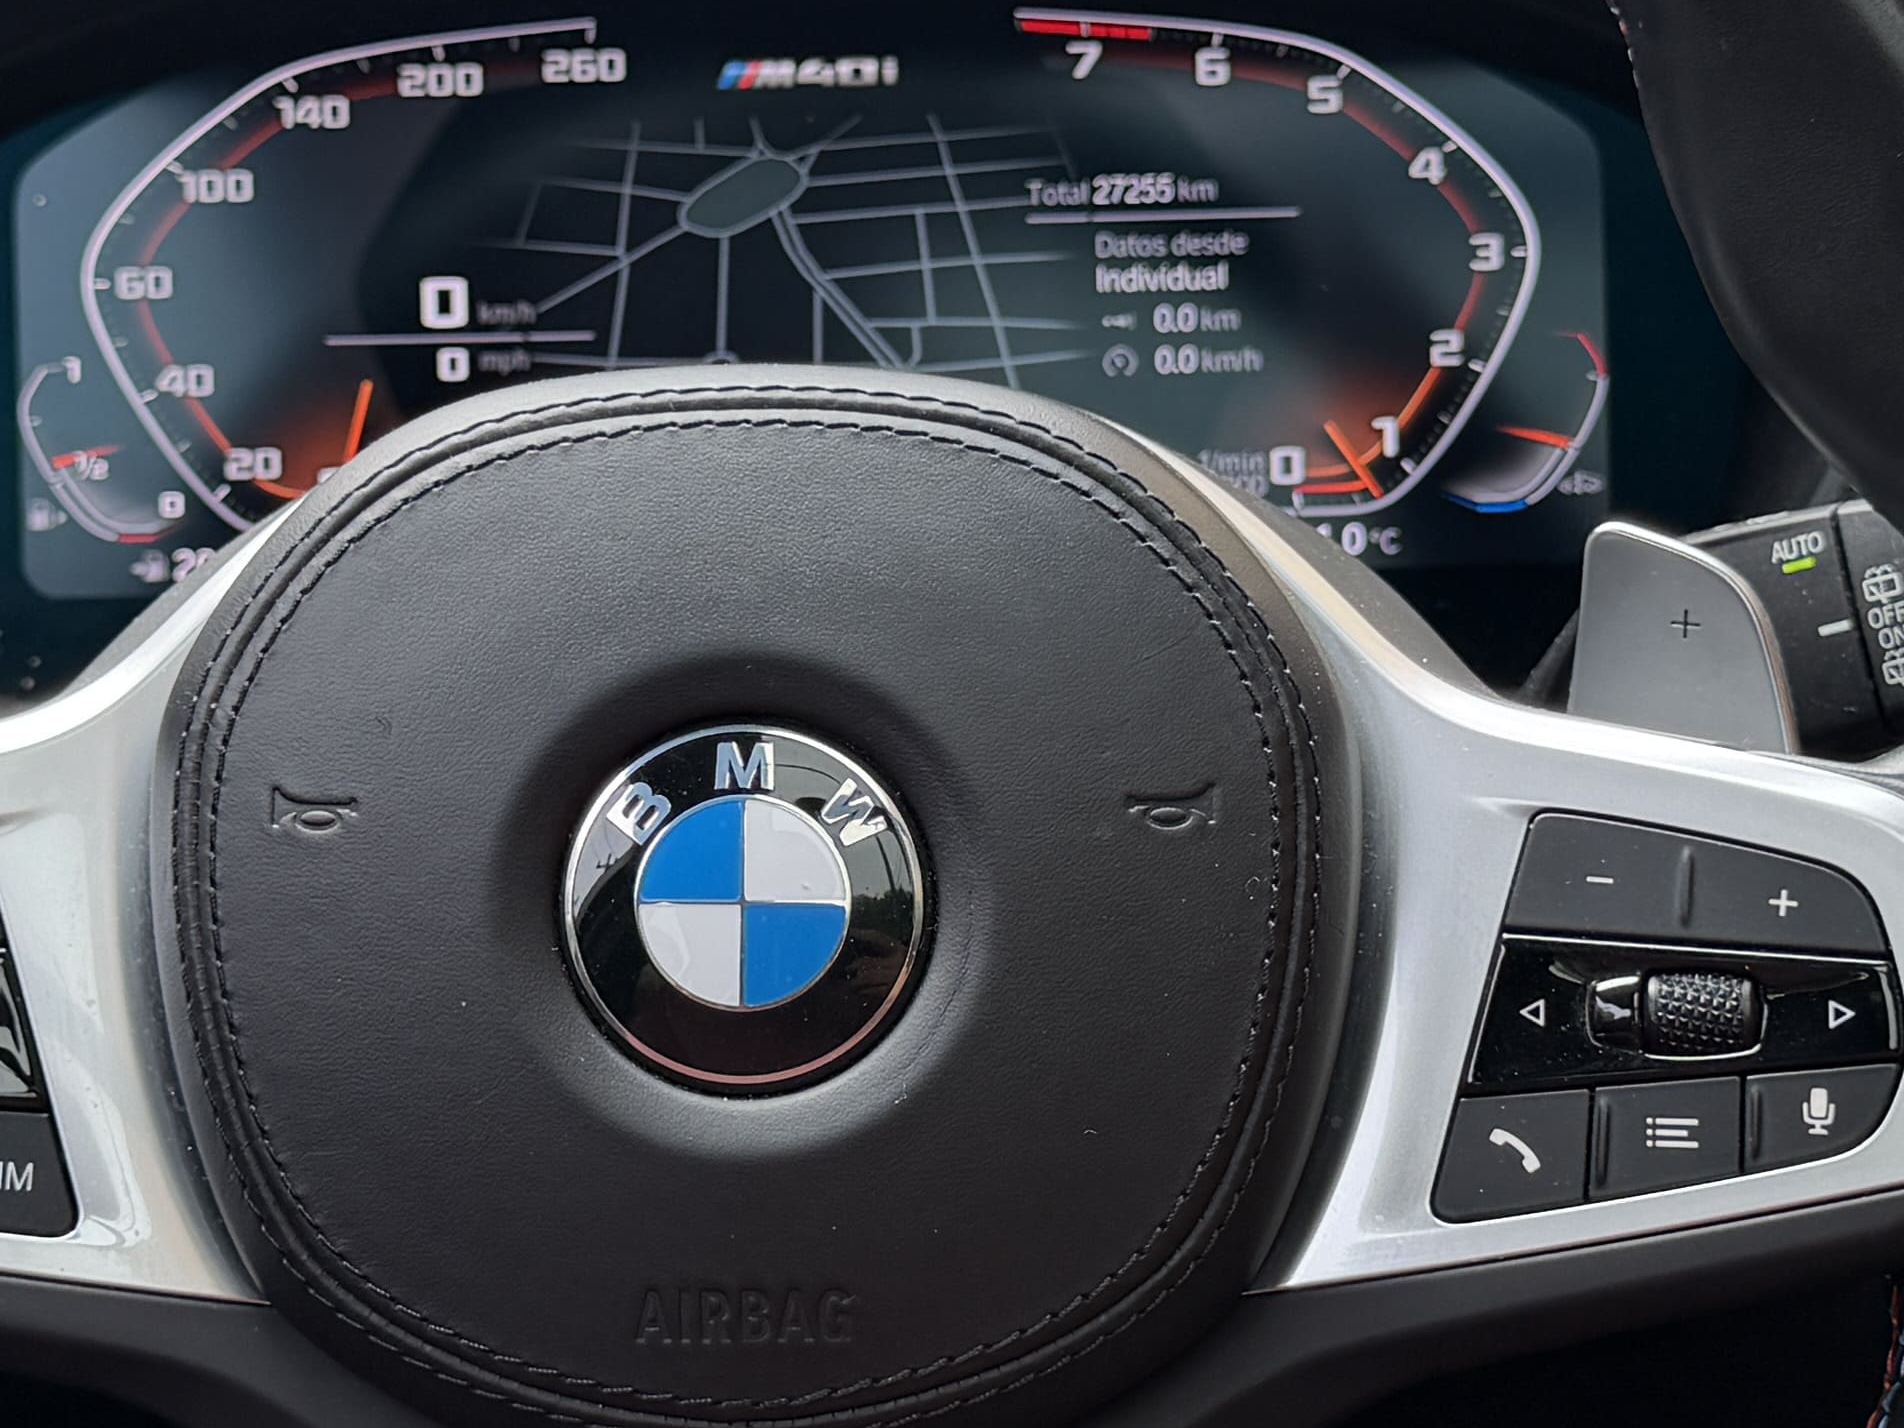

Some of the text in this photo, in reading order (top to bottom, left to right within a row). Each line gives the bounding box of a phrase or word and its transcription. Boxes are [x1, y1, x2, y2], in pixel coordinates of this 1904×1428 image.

[540, 47, 627, 84] 260
[1064, 41, 1103, 79] 7
[1193, 46, 1232, 86] 6
[396, 61, 484, 98] 200
[1306, 75, 1345, 115] 5
[273, 93, 351, 130] 140
[1407, 148, 1447, 184] 4
[179, 168, 255, 204] 100
[1024, 172, 1220, 206] Total 27255 km
[1095, 227, 1250, 259] Datos desde
[1467, 231, 1506, 271] 3
[114, 265, 174, 301] 60
[1096, 259, 1229, 294] Individual
[419, 275, 537, 330] 0 km/h
[1153, 302, 1242, 334] 0.0 km
[435, 346, 533, 383] 0 mph
[1154, 343, 1265, 375] 0.0 km/h
[1429, 329, 1467, 369] 2
[62, 356, 83, 385] 1
[154, 363, 215, 398] 40
[1371, 415, 1400, 458] 1
[223, 446, 283, 482] 20
[1269, 444, 1306, 486] 0
[157, 490, 186, 520] 0
[1771, 530, 1828, 564] AUTO
[606, 740, 888, 848] BMW
[633, 1285, 859, 1346] AIRBAG
